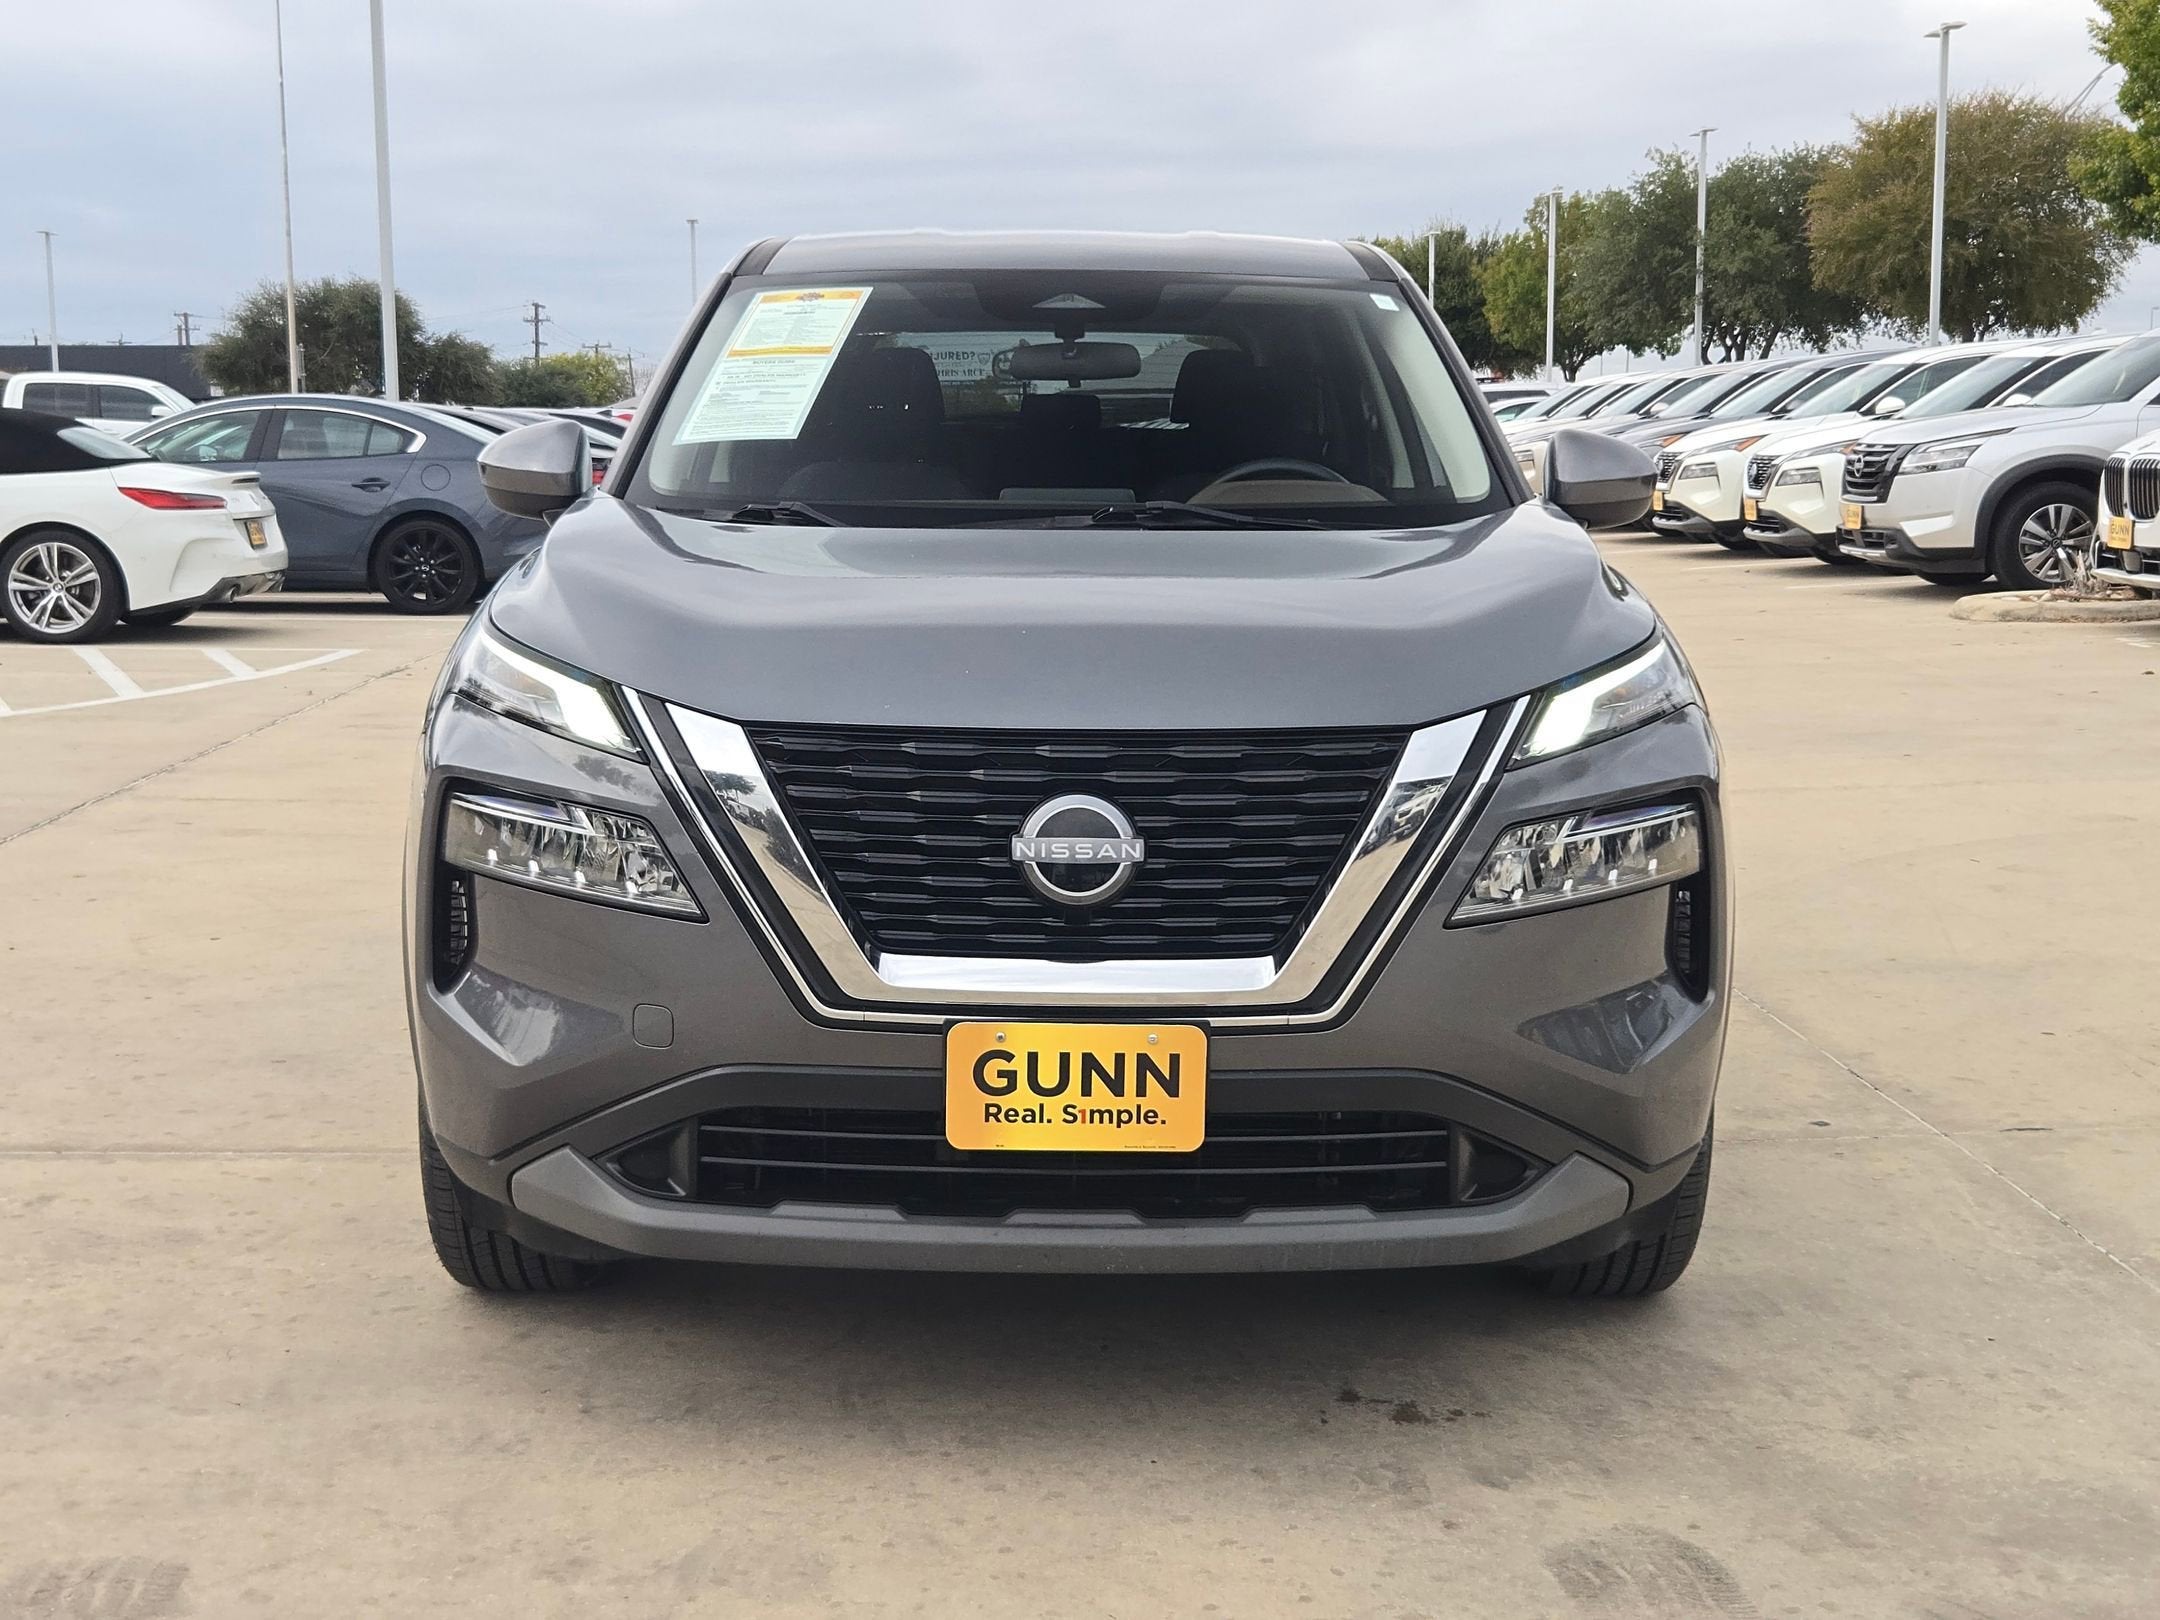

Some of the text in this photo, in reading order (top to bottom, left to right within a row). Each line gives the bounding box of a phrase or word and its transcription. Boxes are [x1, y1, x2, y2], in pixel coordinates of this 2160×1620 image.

[930, 351, 976, 361] JURED?
[1016, 842, 1140, 859] NISSAN
[972, 1049, 1180, 1098] GUNN
[984, 1102, 1052, 1124] Real.
